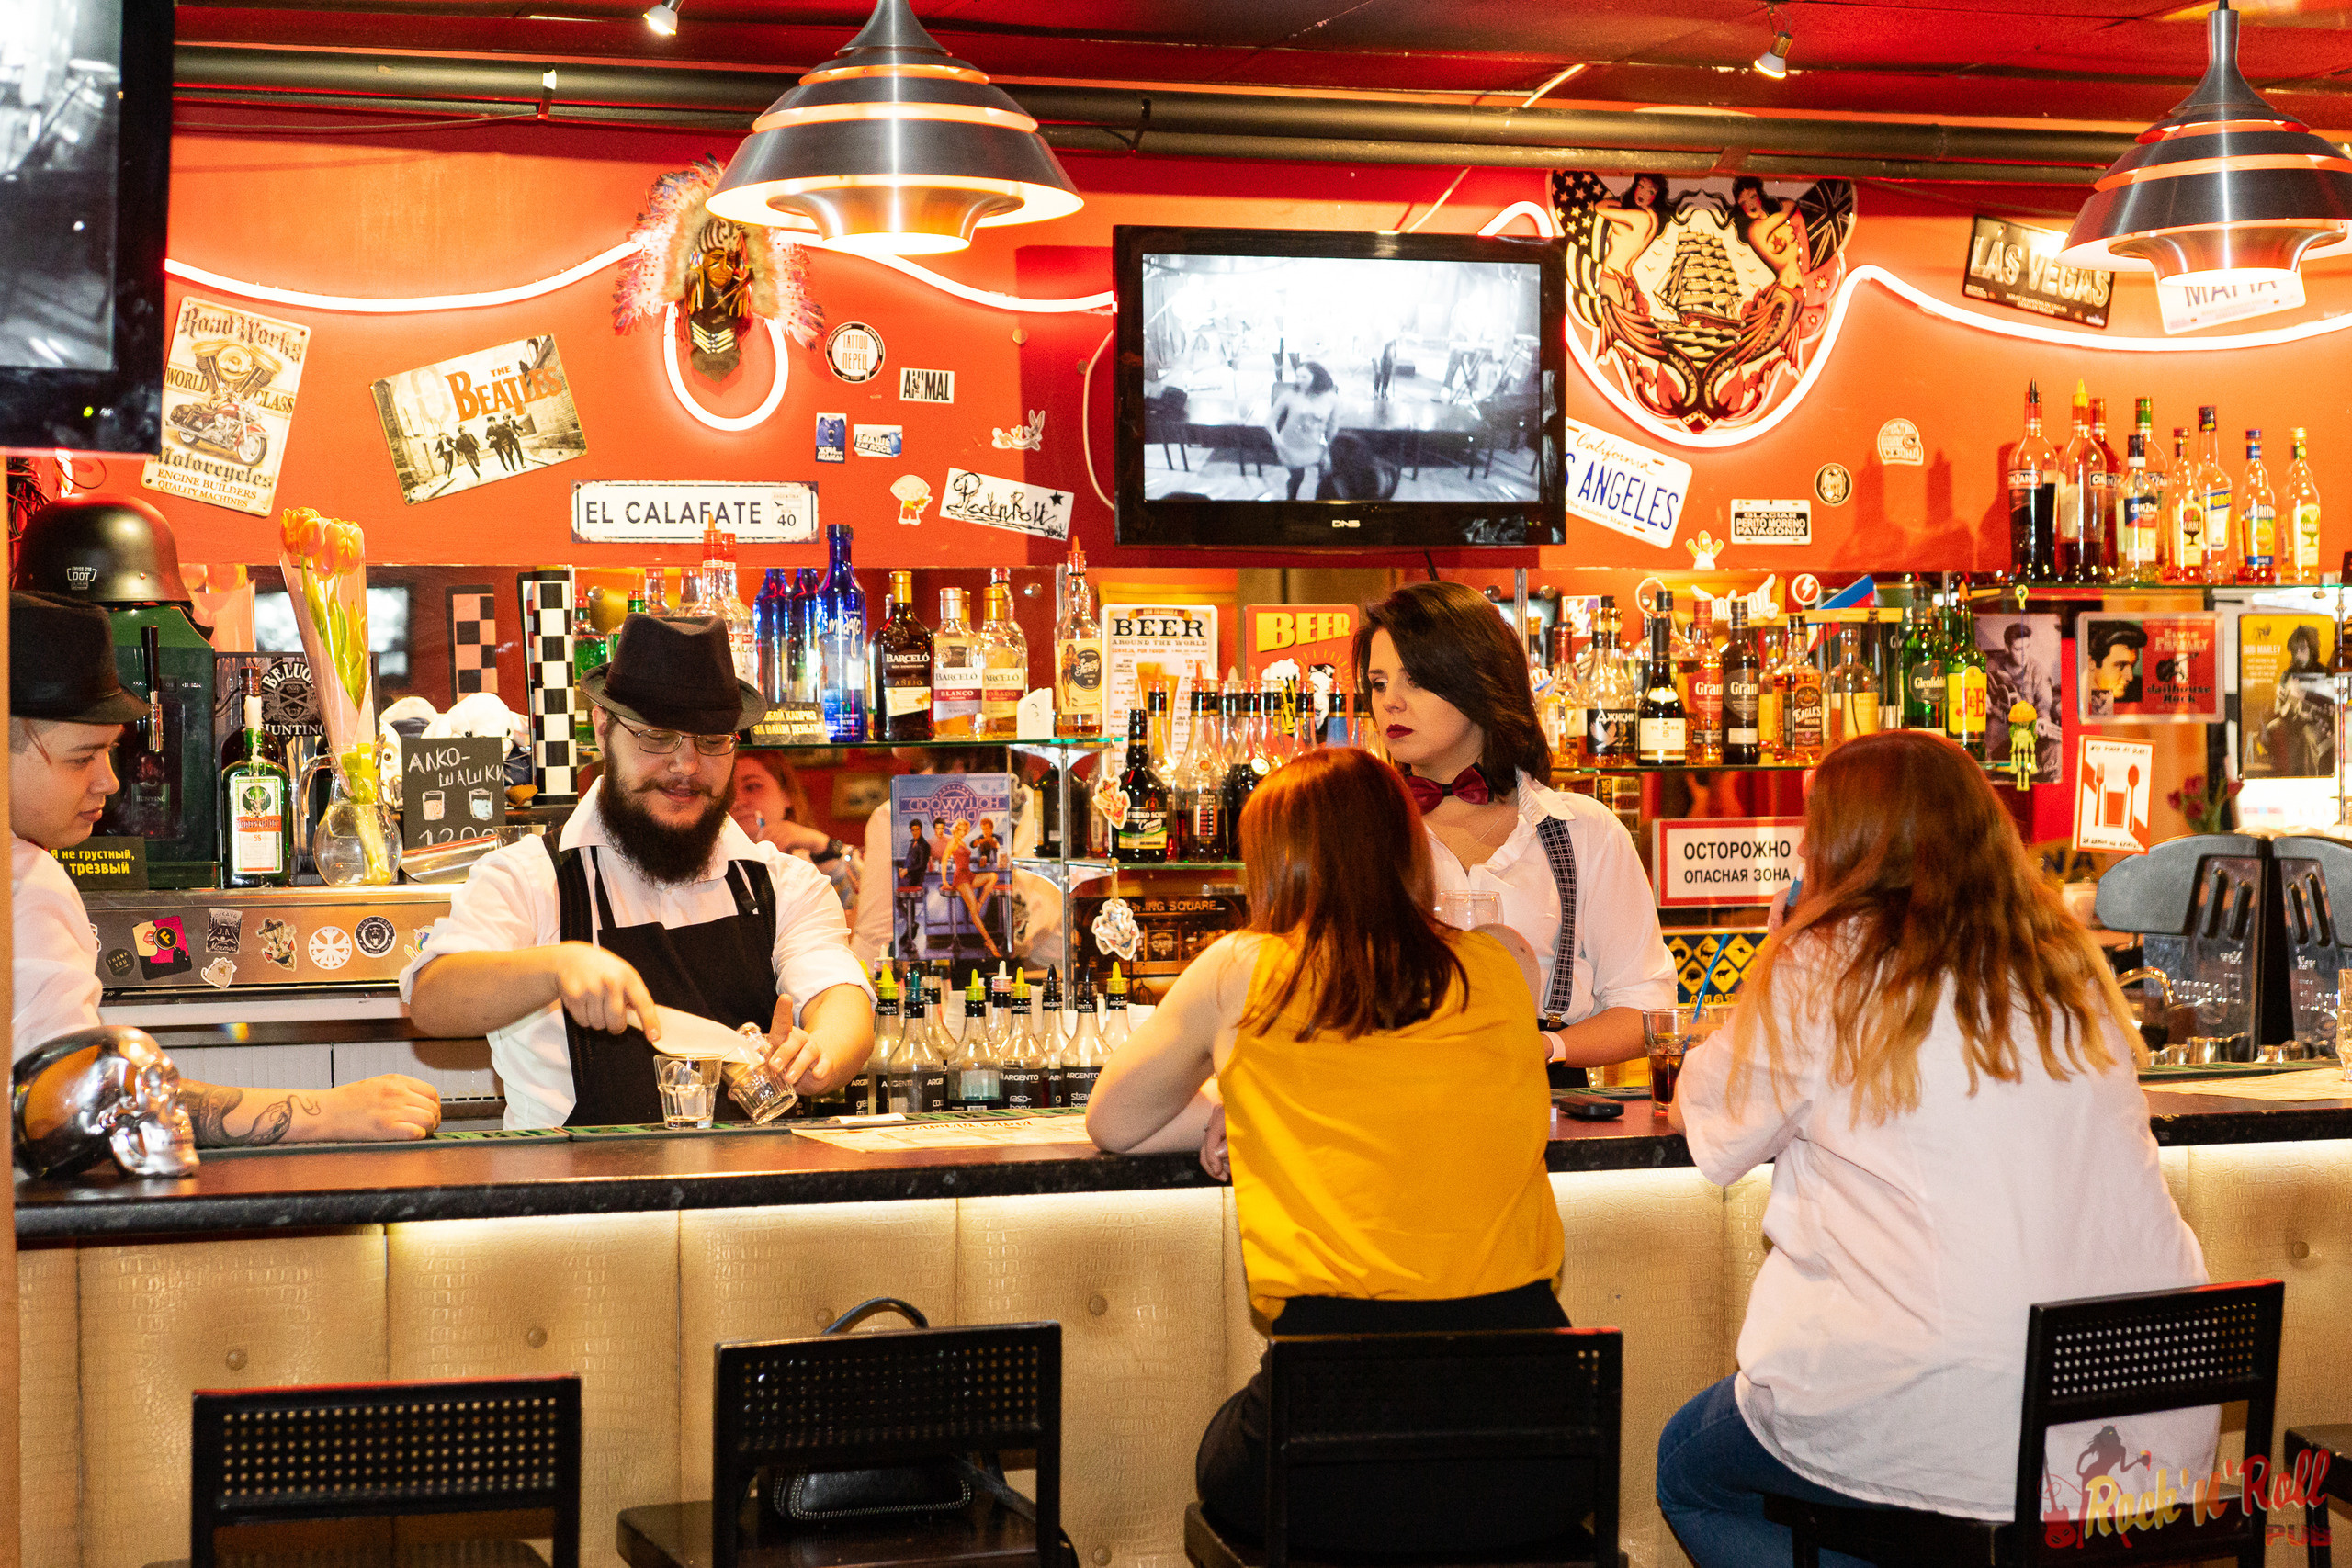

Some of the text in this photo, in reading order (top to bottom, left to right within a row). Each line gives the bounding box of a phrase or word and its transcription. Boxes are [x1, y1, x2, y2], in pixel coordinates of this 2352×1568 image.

[1970, 235, 2111, 309] LAS VEGAS
[180, 306, 304, 364] Road Works
[842, 334, 868, 350] TATTOO
[842, 353, 868, 370] ПЕРЕЦ
[165, 367, 209, 393] WORLD
[490, 366, 512, 378] THE
[902, 369, 950, 401] ANIMAL
[254, 389, 295, 413] CLASS
[444, 366, 563, 423] BEATLES
[1577, 432, 1655, 476] California
[157, 446, 272, 488] Motorcycles
[157, 468, 257, 500] ENGINE BUILDERS
[157, 480, 249, 509] QUALITY MACHINES
[1577, 460, 1679, 531] ANGELES
[586, 501, 762, 524] EL CALAFATE
[2130, 502, 2158, 513] CINZAN
[776, 513, 797, 527] 40
[1331, 519, 1361, 528] DNS
[1580, 504, 1608, 520] Golden
[1610, 515, 1629, 528] State
[1736, 518, 1806, 529] PERITO MORENO
[1736, 526, 1805, 536] PATAGONIA
[73, 571, 90, 581] DOT
[1113, 618, 1204, 637] BEER
[1256, 612, 1351, 653] BEER
[2256, 644, 2281, 655] MARLEY
[886, 653, 931, 663] BARCELÓ
[261, 661, 317, 689] BELUG
[935, 671, 978, 682] BARCELÓ
[986, 673, 1020, 682] ARCELÓ
[763, 709, 786, 720] БОЙ
[753, 725, 765, 734] ЗА
[765, 724, 790, 735] ВАШИ
[439, 764, 504, 787] ШАШКИ
[62, 850, 76, 859] не
[79, 849, 135, 861] грустный,
[1684, 840, 1791, 860] ОСТОРОЖНО
[69, 861, 130, 876] трезвый
[1684, 868, 1791, 884] ОПАСНАЯ ЗОНА
[1169, 900, 1216, 911] SQUARE
[159, 931, 172, 944] F
[1009, 1094, 1032, 1104] rasp-
